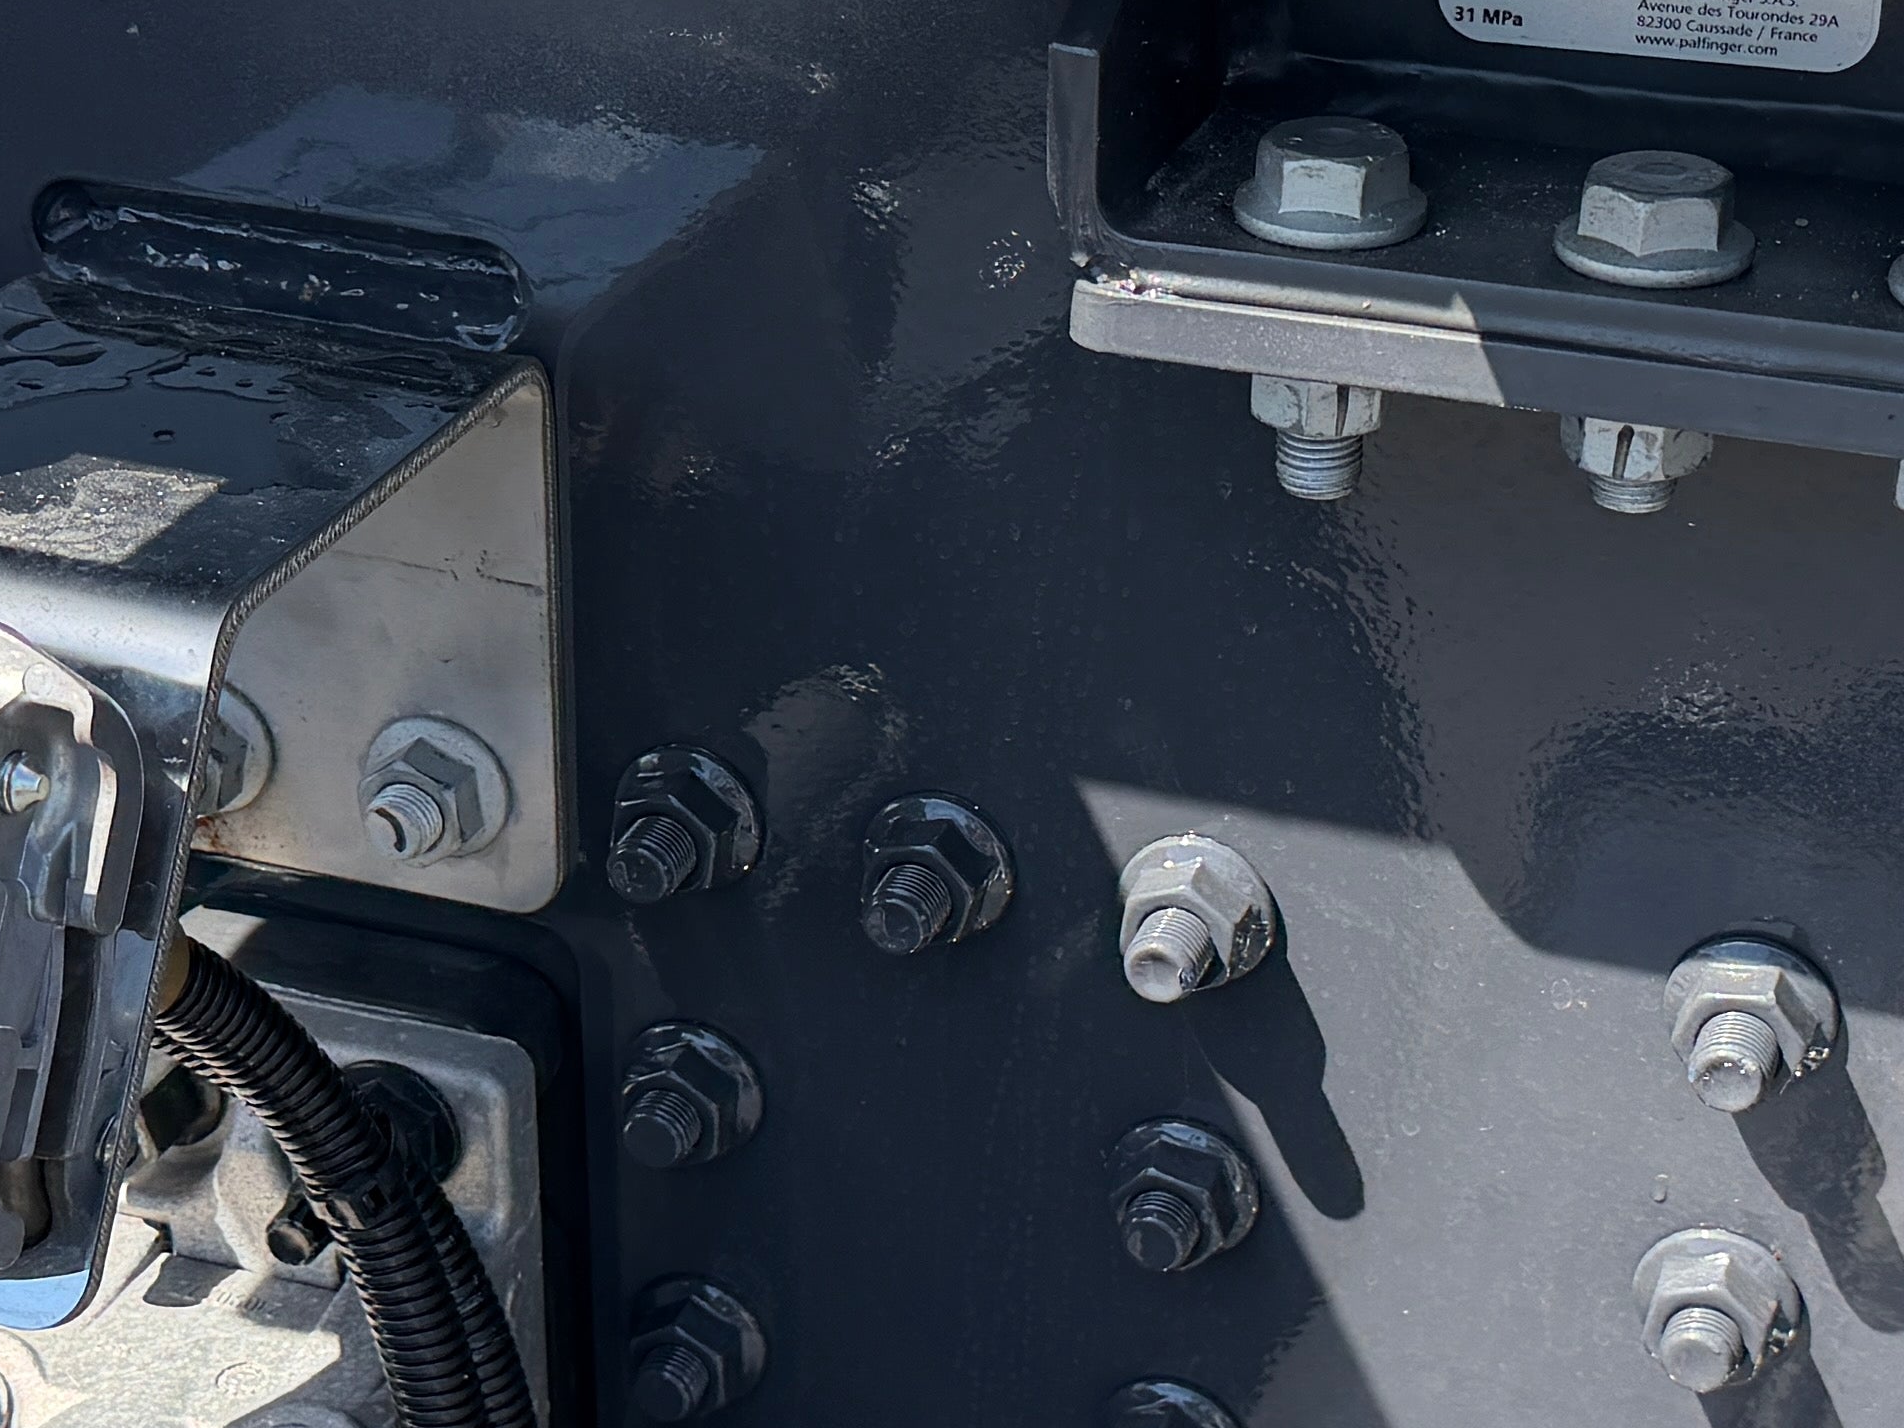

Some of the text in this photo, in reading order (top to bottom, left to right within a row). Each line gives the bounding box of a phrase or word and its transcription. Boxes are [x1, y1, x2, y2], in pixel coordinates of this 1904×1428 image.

[1454, 5, 1524, 28] 31 MPa
[1697, 2, 1723, 19] des
[1727, 5, 1806, 26] Tourondes
[1808, 12, 1839, 29] 29A
[1636, 15, 1818, 43] 82300 Caussade / France
[1634, 32, 1779, 58] www.palfinger.com
